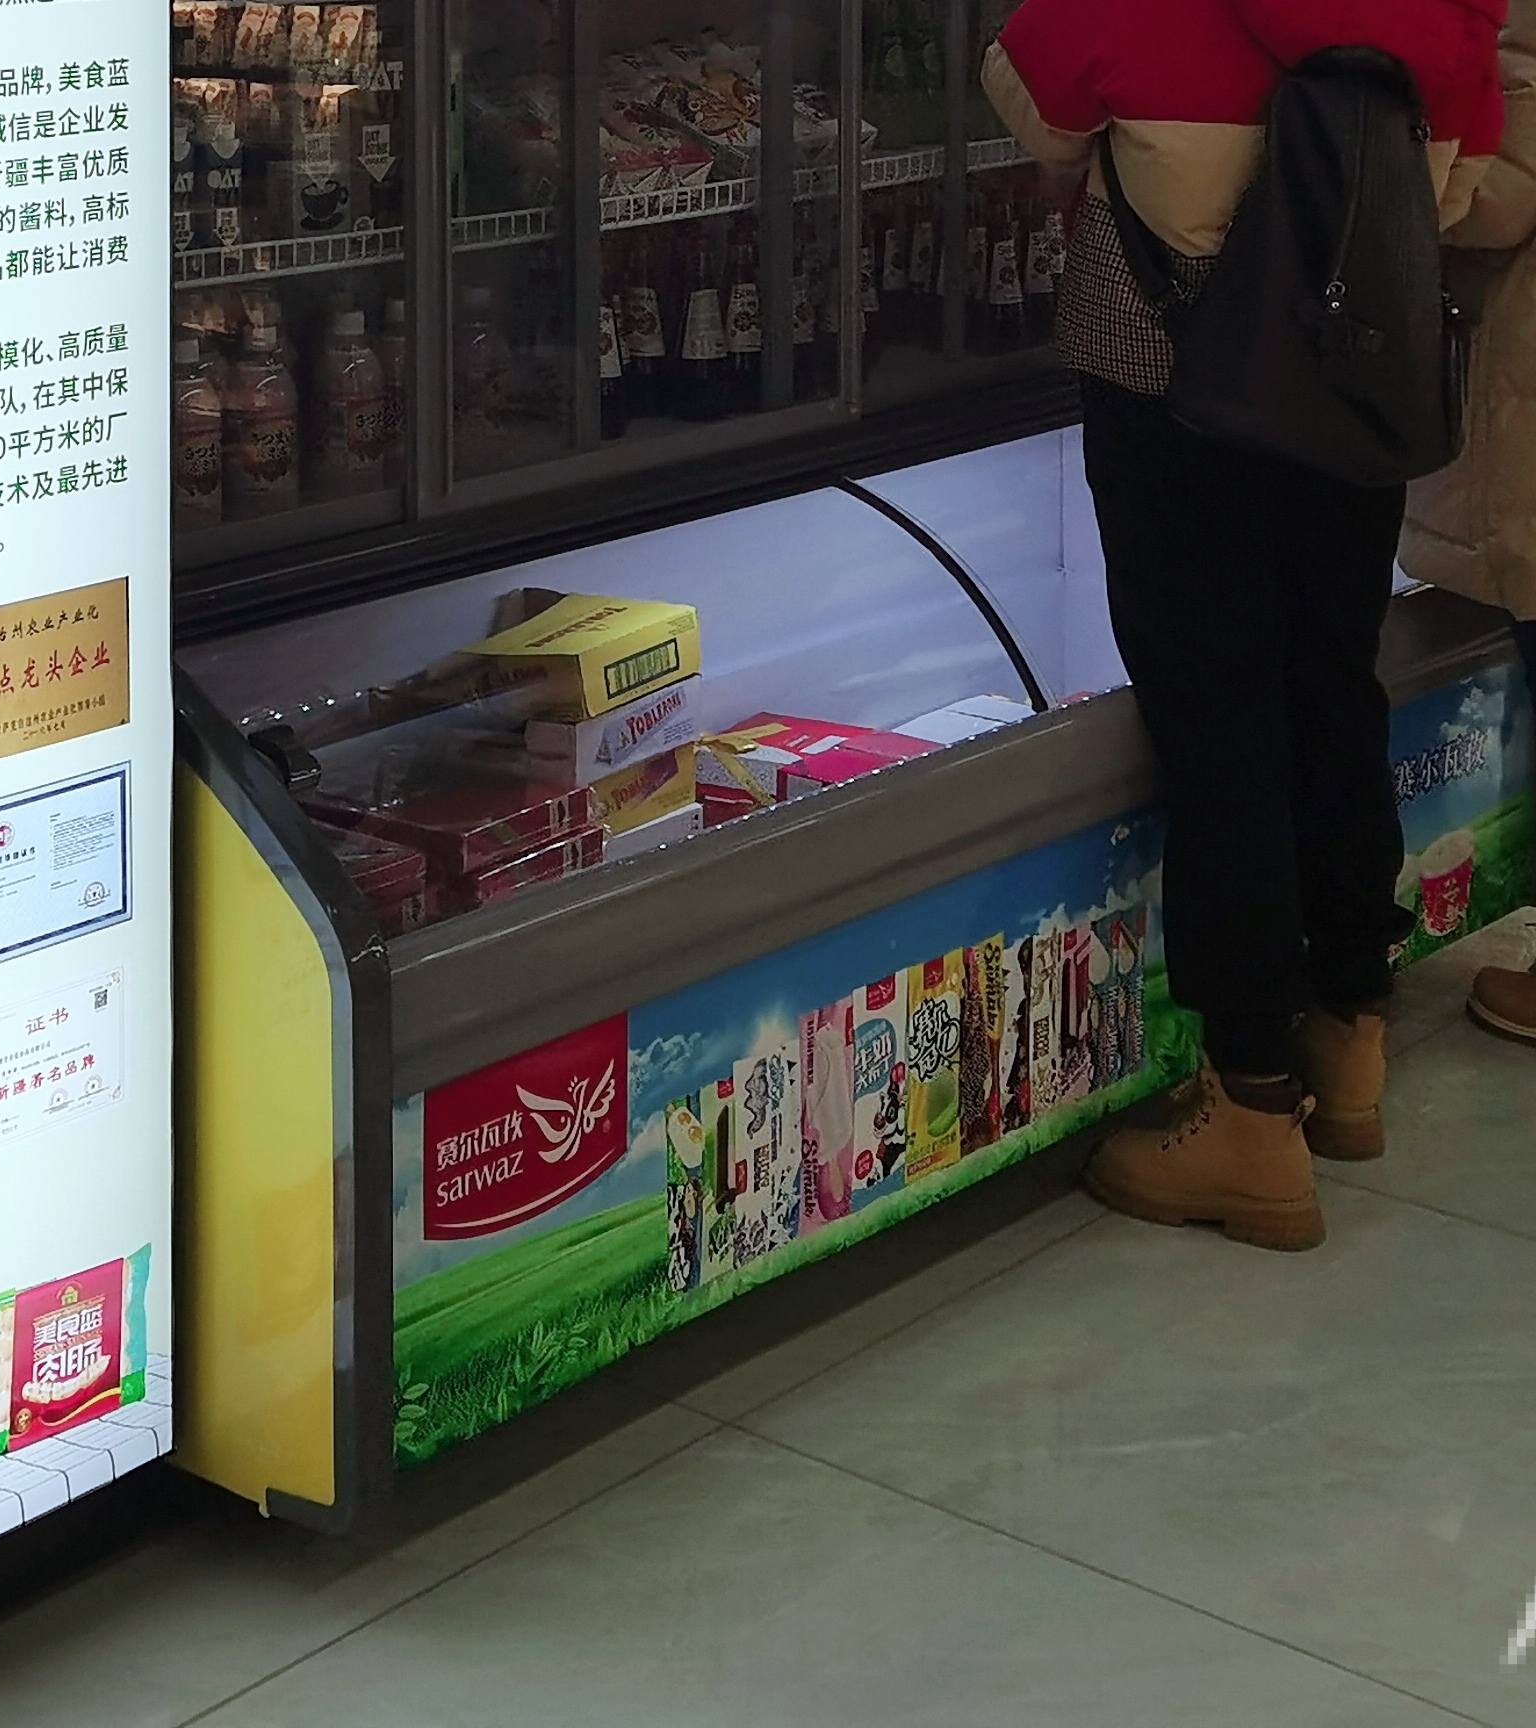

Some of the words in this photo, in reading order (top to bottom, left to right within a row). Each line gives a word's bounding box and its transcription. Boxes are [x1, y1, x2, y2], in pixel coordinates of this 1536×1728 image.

[24, 1006, 69, 1036] 证书
[435, 1107, 525, 1174] 赛尔瓦孜
[435, 1151, 526, 1207] sarwaz
[33, 1303, 104, 1348] 美食蓝
